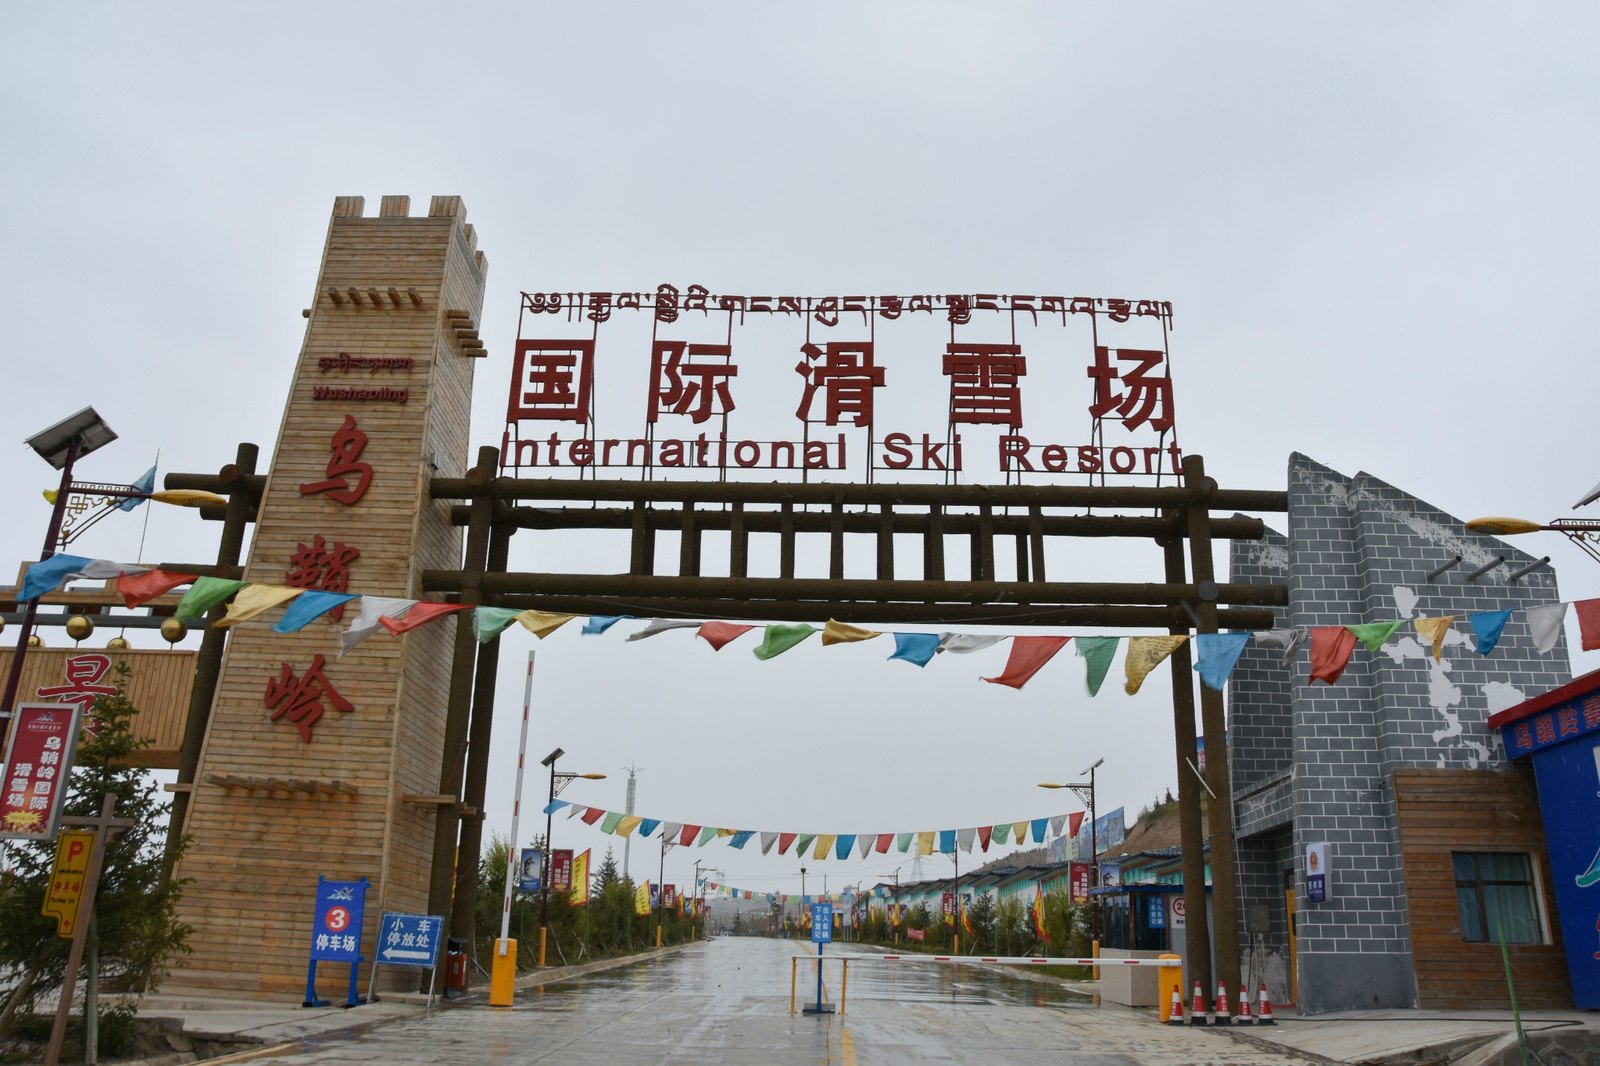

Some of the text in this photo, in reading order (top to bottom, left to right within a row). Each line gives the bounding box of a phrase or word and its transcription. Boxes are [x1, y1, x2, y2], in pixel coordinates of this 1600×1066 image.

[313, 386, 408, 404] Wushaoling
[506, 339, 1175, 432] 国际滑雪场
[499, 432, 1184, 475] International Ski Resort
[29, 736, 61, 810] 乌鞘岭国际
[6, 763, 32, 807] 滑雪场
[67, 840, 84, 862] P
[330, 909, 346, 929] 3
[316, 933, 356, 952] 停车场
[387, 931, 430, 948] 停放处
